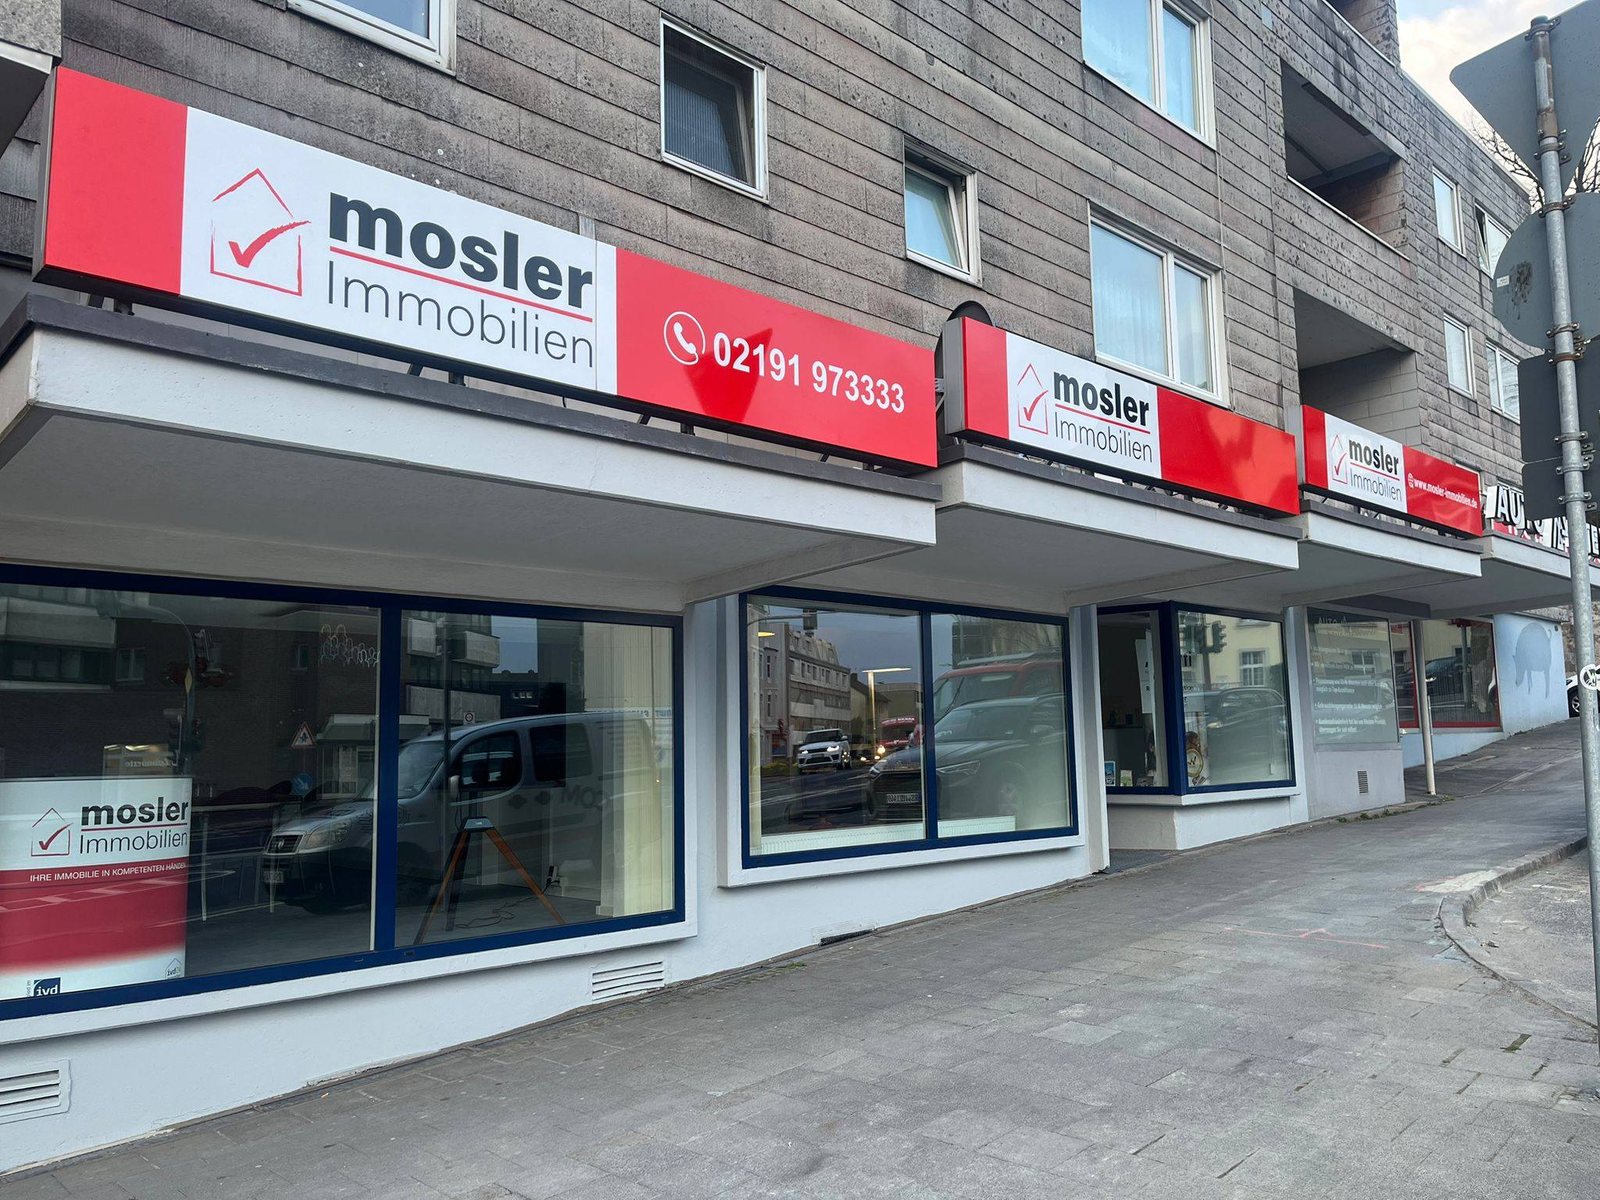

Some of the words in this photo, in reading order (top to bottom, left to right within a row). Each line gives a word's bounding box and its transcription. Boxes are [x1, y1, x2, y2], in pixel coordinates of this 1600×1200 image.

[329, 191, 593, 309] mosler
[328, 260, 593, 368] Immobilien
[713, 332, 800, 386] 02191
[812, 361, 905, 413] 973333
[1053, 371, 1150, 427] mosler
[1055, 411, 1153, 463] Immobilien
[1348, 439, 1399, 476] mosler
[1350, 468, 1403, 501] Immobilien
[81, 796, 189, 826] mosler
[80, 830, 188, 854] Immobilien
[30, 874, 52, 882] IHRE
[54, 870, 100, 881] IMMOBILIE
[102, 869, 110, 877] IN
[112, 864, 165, 876] KOMPETENTEN
[36, 984, 58, 997] ivd
